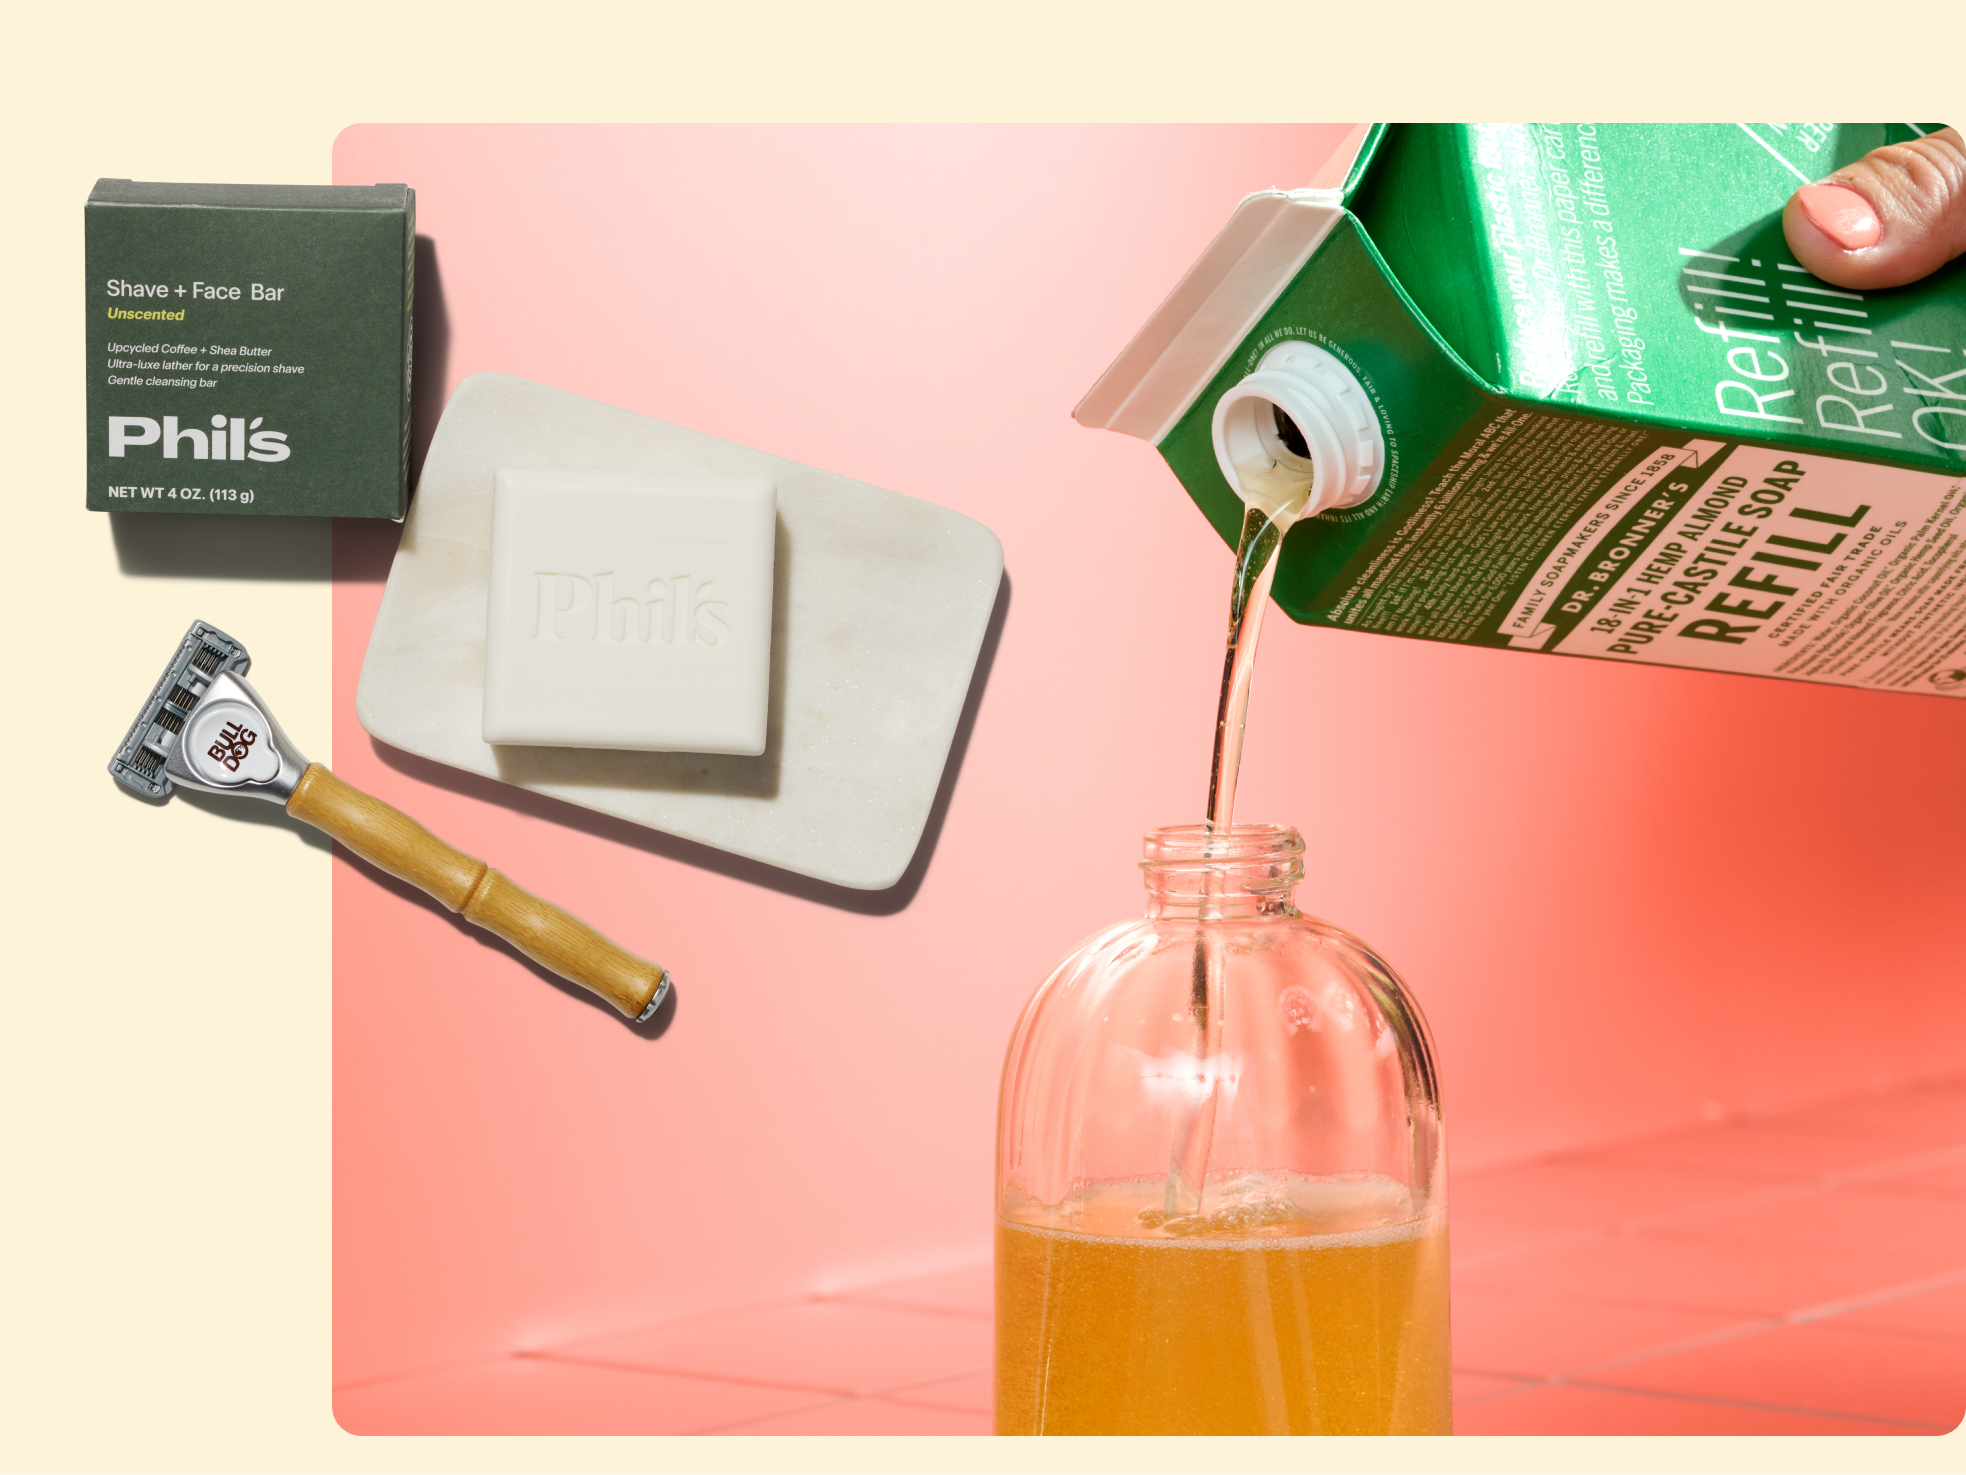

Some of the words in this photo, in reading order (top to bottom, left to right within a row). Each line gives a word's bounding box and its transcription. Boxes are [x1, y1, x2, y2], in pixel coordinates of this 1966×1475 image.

[1543, 123, 1565, 159] car
[1578, 124, 1609, 215] differenc
[1549, 162, 1583, 224] paper
[1484, 173, 1525, 249] plastic
[1594, 220, 1612, 232] a
[1558, 227, 1585, 264] this
[1499, 249, 1534, 299] your
[1596, 236, 1627, 302] makes
[106, 279, 169, 298] Shave
[174, 285, 187, 297] +
[192, 281, 241, 300] Face
[250, 283, 285, 301] Bar
[1565, 268, 1595, 311] with
[107, 307, 186, 322] Unscented
[1264, 332, 1275, 344] ALL
[1274, 328, 1283, 338] WE
[1296, 326, 1307, 336] LET
[1309, 329, 1317, 339] US
[1319, 334, 1327, 344] BE
[1574, 314, 1605, 359] refill
[1678, 247, 1804, 424] Refill!
[107, 342, 159, 356] Upcycled
[161, 343, 198, 355] Coffee
[209, 345, 238, 355] Shea
[239, 346, 273, 357] Butter
[1257, 340, 1265, 350] IN
[1514, 303, 1546, 388] Reduce
[1611, 304, 1653, 404] Packaging
[107, 359, 160, 370] Ultra-luxe
[162, 360, 193, 371] lather
[194, 361, 210, 371] for
[211, 364, 219, 372] a
[220, 362, 271, 374] precision
[272, 363, 305, 374] shave
[1243, 349, 1259, 378] LL-ONE!
[107, 375, 144, 386] Gentle
[145, 376, 197, 389] cleansing
[199, 377, 218, 388] bar
[1362, 376, 1376, 395] FAIR
[1584, 363, 1618, 400] and
[1378, 404, 1394, 436] LOVING
[1493, 407, 1518, 423] that
[1498, 410, 1534, 436] All-One.
[1521, 415, 1549, 438] mankind
[108, 413, 291, 463] Phil's
[1477, 421, 1502, 439] ABC
[1514, 436, 1528, 444] all
[1389, 437, 1397, 448] TO
[1458, 437, 1488, 459] Moral
[1476, 450, 1492, 459] &
[1483, 434, 1509, 453] we're
[1501, 442, 1521, 456] unite
[1387, 449, 1399, 490] SPACESHIP
[1446, 458, 1468, 472] the
[1456, 457, 1488, 481] strong
[1482, 461, 1502, 477] Jesus
[108, 486, 138, 498] NET
[140, 487, 165, 499] WT
[167, 487, 178, 499] 4
[179, 488, 206, 500] OZ.
[209, 488, 237, 502] (113
[239, 489, 255, 503] g)
[1427, 471, 1456, 496] Teach
[1437, 479, 1466, 504] billion
[1465, 476, 1490, 495] taught
[1375, 488, 1394, 508] EARTH
[1452, 494, 1472, 510] Hillel
[1524, 529, 1557, 561] CHILDREN
[1551, 501, 1582, 528] ETERNAL
[1576, 478, 1603, 501] FATHER
[1597, 446, 1635, 478] ETERNALLY
[1339, 513, 1353, 523] ITS
[1351, 511, 1365, 521] ALL
[1364, 505, 1379, 517] AND
[1393, 495, 1436, 536] Godliness!
[1438, 510, 1460, 527] Rabbi
[1406, 509, 1443, 542] instantly
[1428, 526, 1445, 538] real
[1387, 535, 1403, 544] is
[1392, 540, 1416, 558] free,
[1420, 537, 1436, 548] the
[1512, 589, 1546, 628] FAMILY
[1541, 513, 1610, 587] SOAPMAKERS
[1605, 478, 1646, 510] SINCE
[1641, 454, 1675, 477] 1858
[1561, 586, 1599, 613] DR.
[1588, 483, 1688, 582] BRONNER'S
[1352, 543, 1397, 585] cleanliness
[1590, 588, 1651, 634] 18-IN-1
[1636, 543, 1687, 584] HEMP
[1677, 477, 1748, 541] ALMOND
[1606, 522, 1759, 654] PURE-CASTILE
[1738, 461, 1806, 518] SOAP
[1829, 603, 1859, 626] Organic
[1852, 579, 1883, 604] Coconut
[1886, 541, 1918, 566] Organic
[1908, 524, 1932, 541] Palm
[1923, 500, 1951, 524] Kernel
[1894, 579, 1918, 596] Citric
[1922, 533, 1959, 566] Tocopherol
[1365, 556, 1401, 589] mankind
[1395, 561, 1416, 578] Moral
[1677, 505, 1871, 644] REFILL
[1842, 608, 1871, 629] Organic
[1863, 595, 1885, 610] Olive
[1888, 561, 1917, 585] Organic
[1909, 543, 1935, 562] Hemp
[1925, 527, 1947, 543] Seed
[1358, 588, 1376, 599] all
[1380, 588, 1397, 599] by
[1386, 577, 1403, 590] The
[1768, 591, 1822, 638] CERTIFIED
[1820, 565, 1847, 588] FAIR
[1844, 526, 1882, 560] TRADE
[1779, 624, 1811, 647] MADE
[1807, 598, 1837, 621] WITH
[1835, 550, 1882, 595] ORGANIC
[1880, 521, 1907, 545] OILS
[531, 571, 729, 646] Phil's
[1323, 584, 1362, 621] Absolute
[1341, 598, 1369, 624] unites
[1365, 597, 1390, 619] taught
[1887, 615, 1917, 638] MEANS
[1913, 595, 1936, 615] SOAP
[1932, 574, 1957, 596] MADE
[1911, 591, 1955, 629] SYNTHETIC
[1359, 619, 1373, 627] As
[207, 721, 243, 762] BULL
[222, 728, 257, 772] DOG
